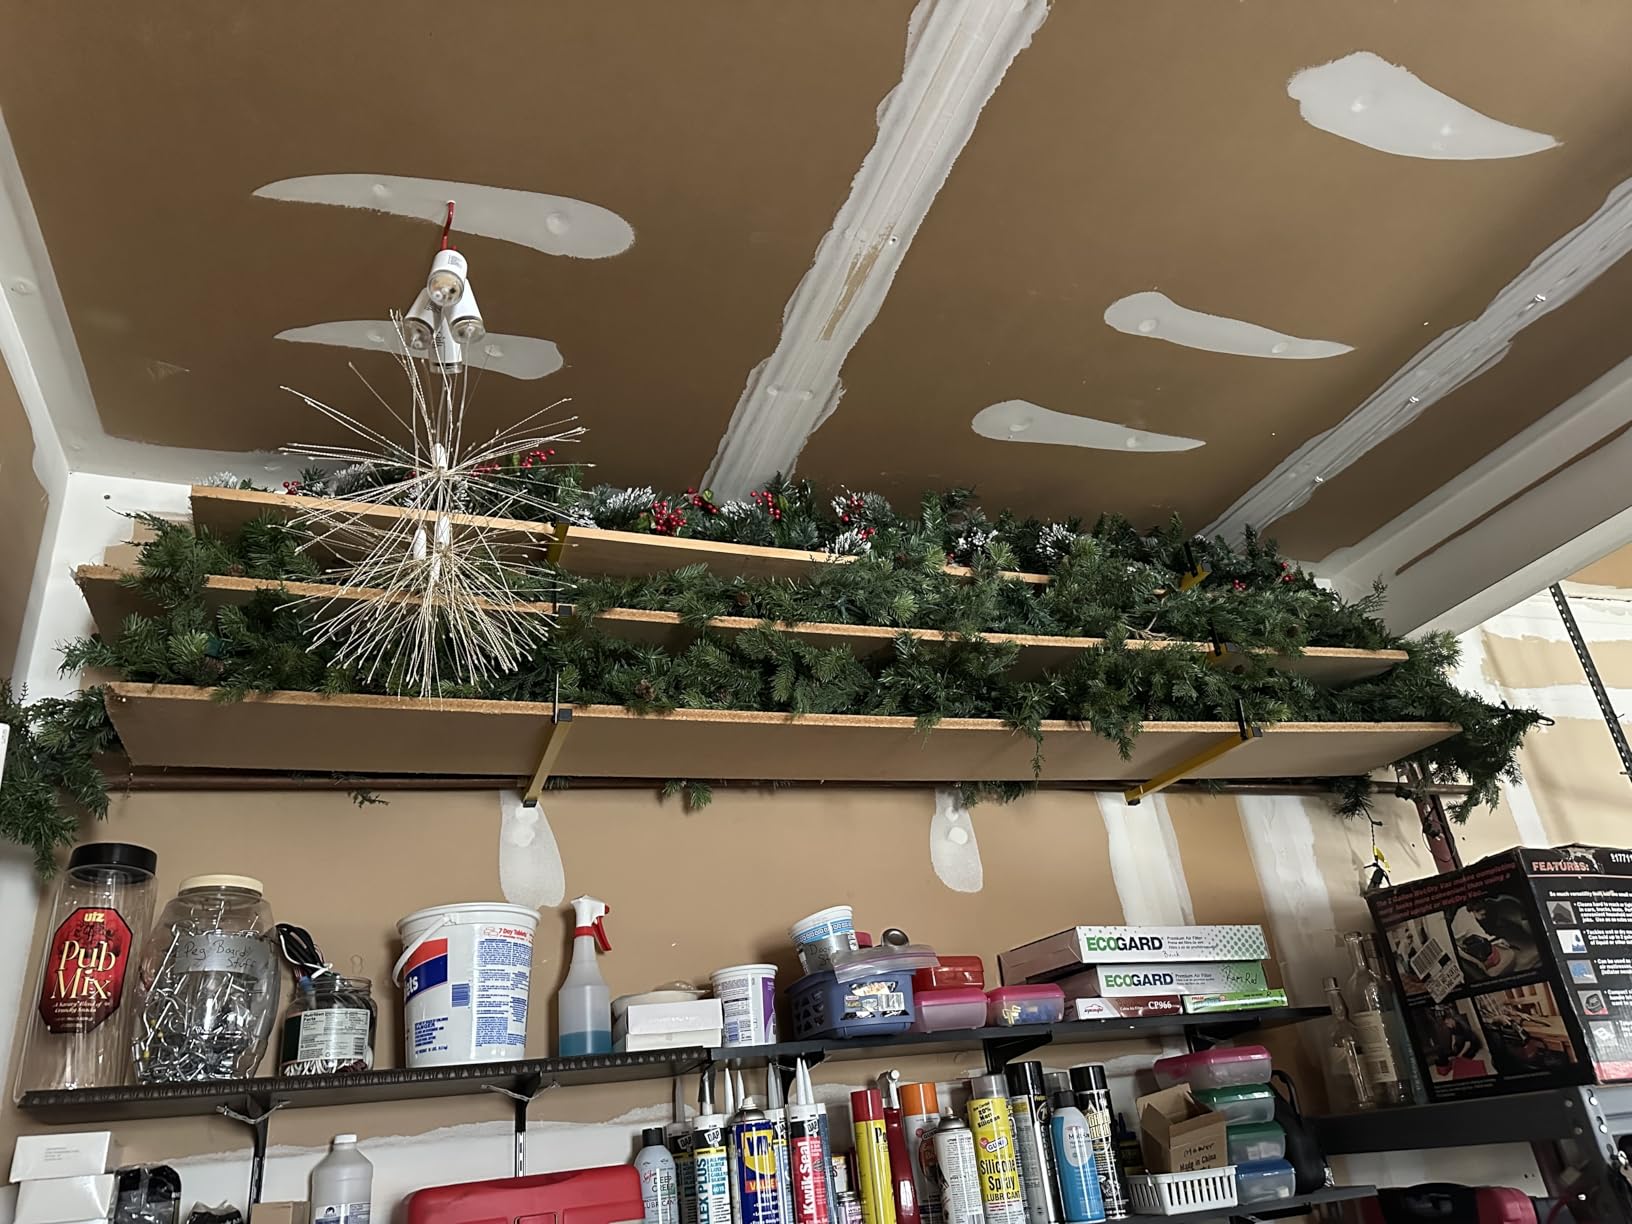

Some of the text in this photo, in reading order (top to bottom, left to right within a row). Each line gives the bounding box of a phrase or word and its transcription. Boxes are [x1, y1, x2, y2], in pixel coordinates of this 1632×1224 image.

[1532, 861, 1590, 872] FEATURES:
[183, 939, 247, 960] Peg Board
[1086, 936, 1163, 951] ECOGARD
[59, 940, 116, 971] Pub
[1104, 974, 1174, 988] ECOGARD
[1147, 1001, 1172, 1010] CP966
[807, 1120, 818, 1132] DAP
[707, 1130, 720, 1142] DAP
[797, 1140, 815, 1215] Kwik Seal
[988, 1175, 1015, 1192] Spray
[697, 1158, 710, 1224] LEX PLUS
[987, 1190, 1019, 1201] LUBRCANT
